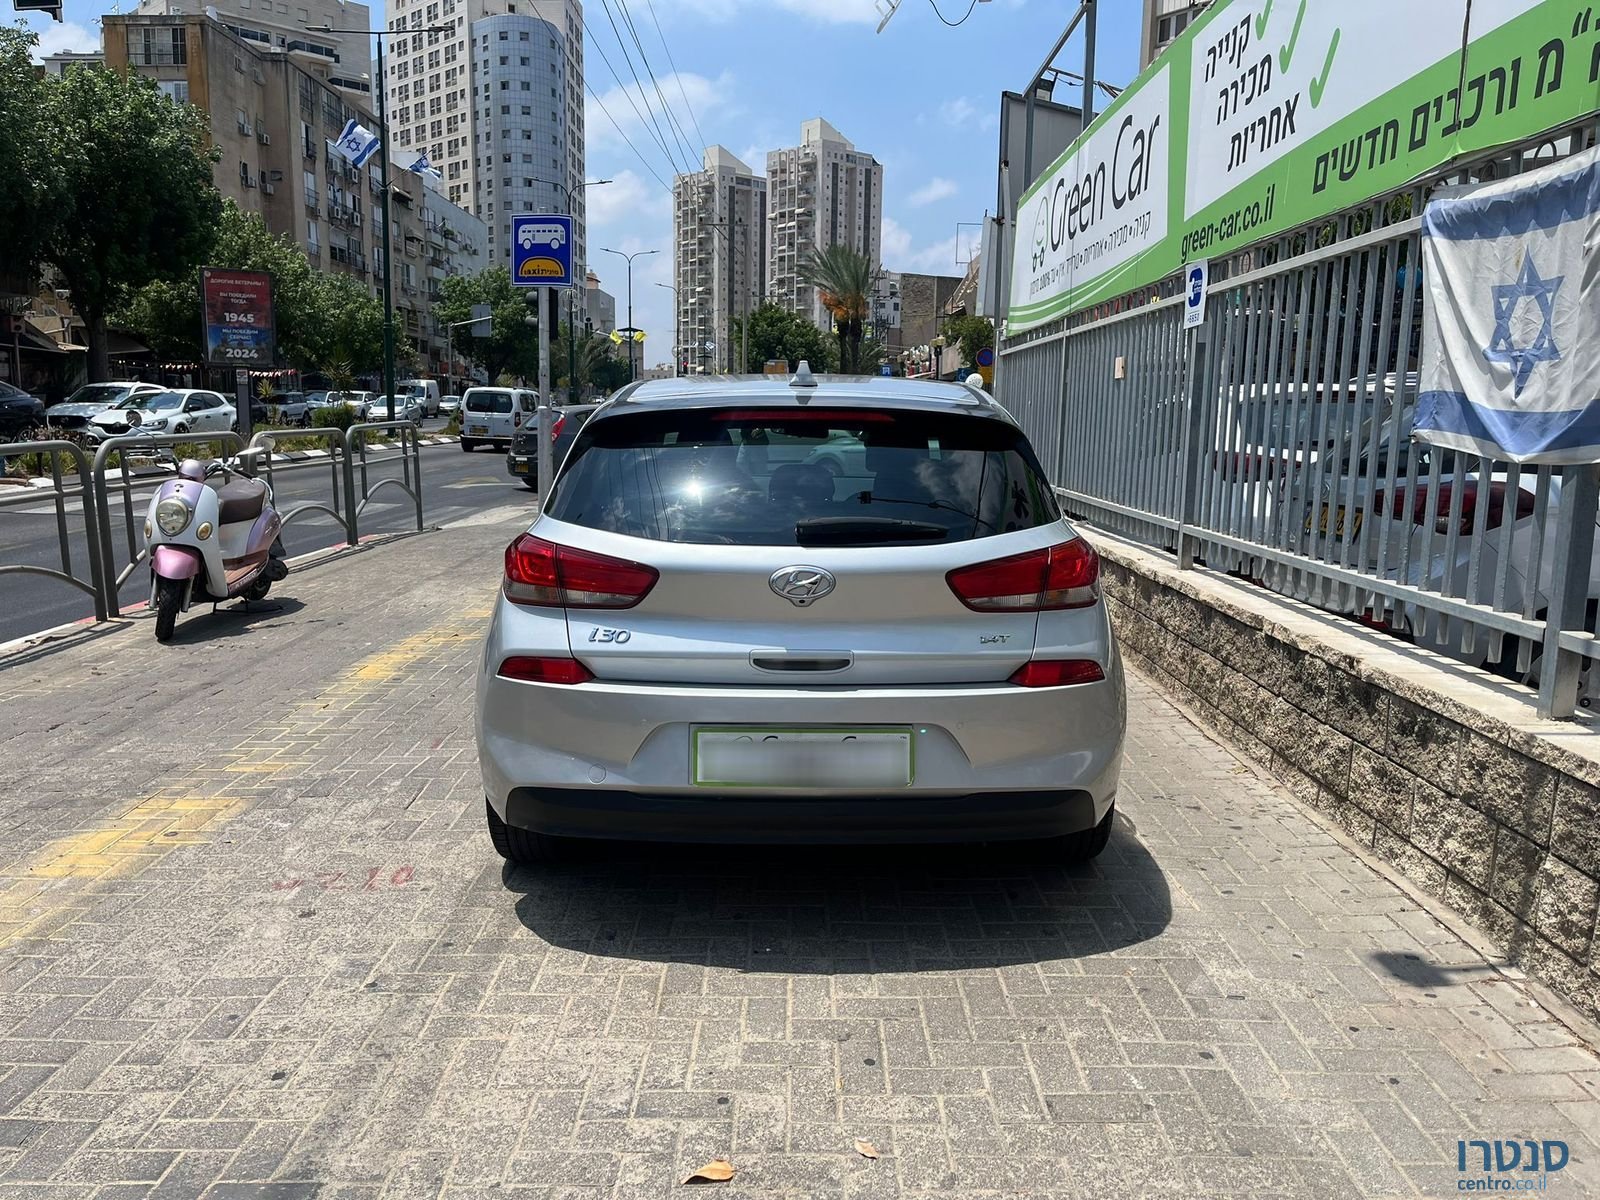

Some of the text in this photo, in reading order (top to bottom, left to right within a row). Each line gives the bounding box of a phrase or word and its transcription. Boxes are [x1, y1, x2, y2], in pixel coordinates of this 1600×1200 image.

[1204, 13, 1252, 83] קנייה
[1216, 53, 1273, 126] מכירה
[1408, 56, 1522, 153] ורכבים
[1226, 91, 1301, 173] אחריות
[1312, 118, 1400, 196] חדשים
[1050, 114, 1161, 252] Green Car
[1181, 183, 1276, 264] green-car.co.il
[224, 312, 255, 323] 1945
[225, 348, 259, 359] 2024
[587, 627, 631, 644] i30
